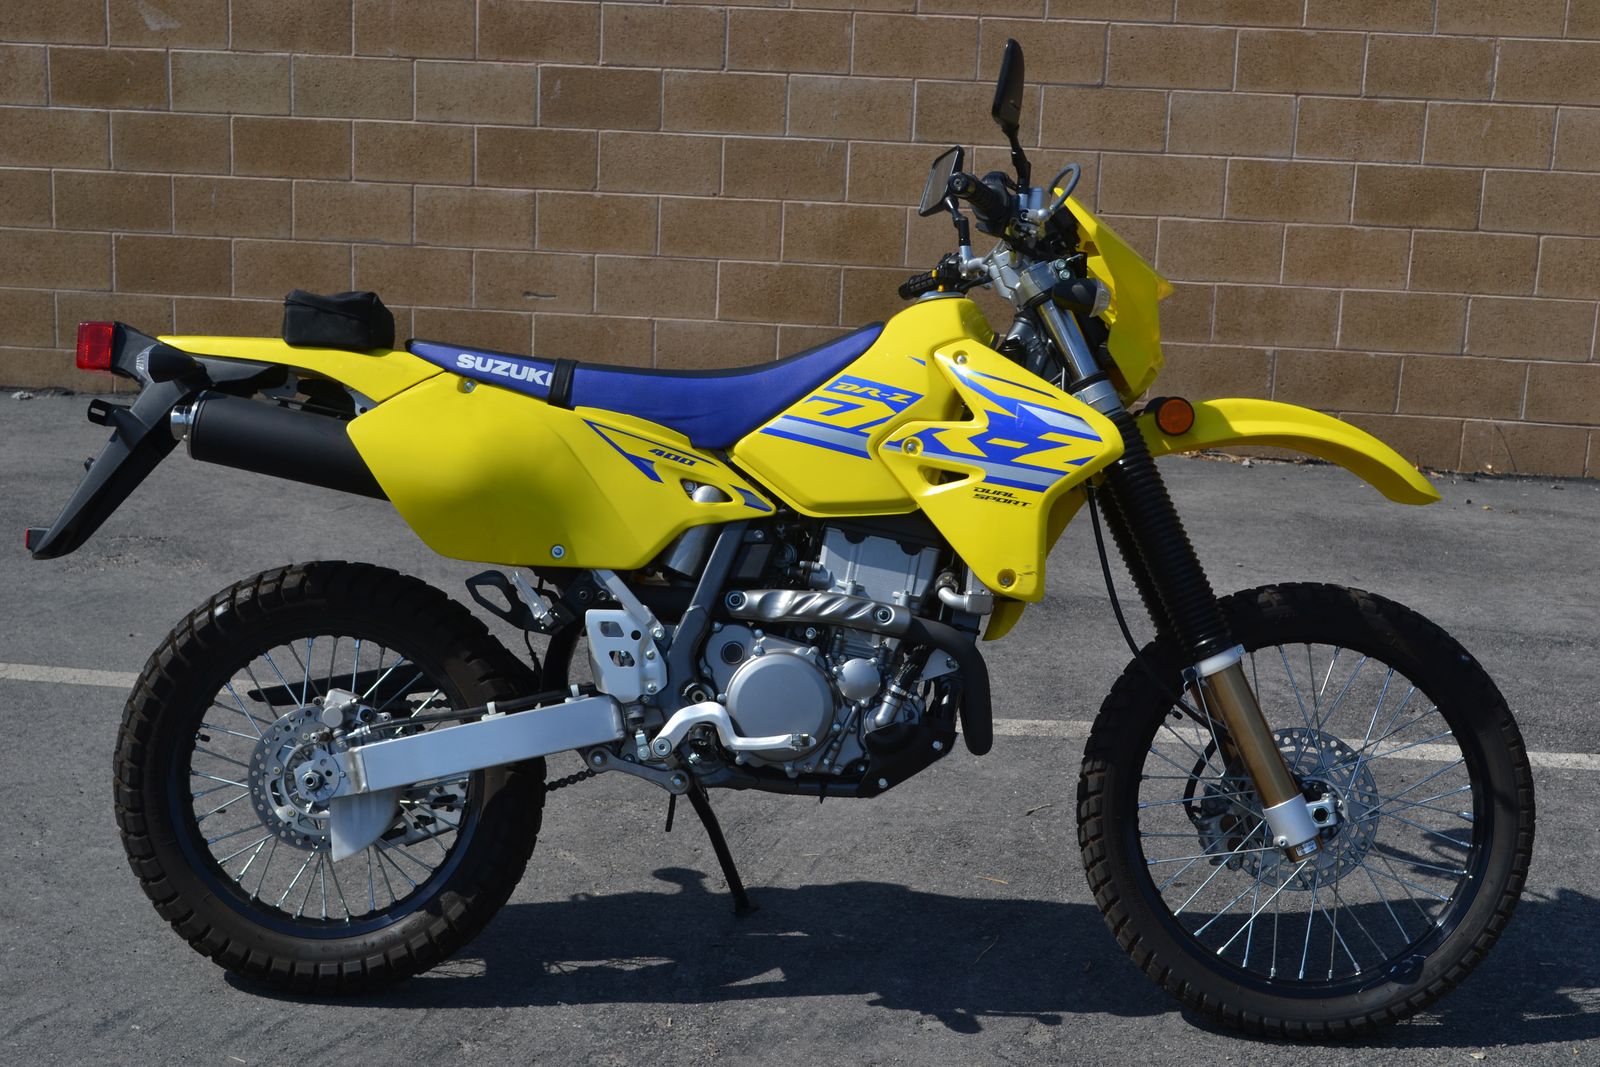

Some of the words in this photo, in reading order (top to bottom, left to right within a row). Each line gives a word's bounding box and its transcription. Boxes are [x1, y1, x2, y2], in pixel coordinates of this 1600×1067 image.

[456, 353, 553, 386] SUZUKI
[832, 381, 912, 404] DR-Z
[648, 449, 696, 466] 400
[973, 487, 1018, 499] DUAL
[973, 493, 1032, 507] SPORT
